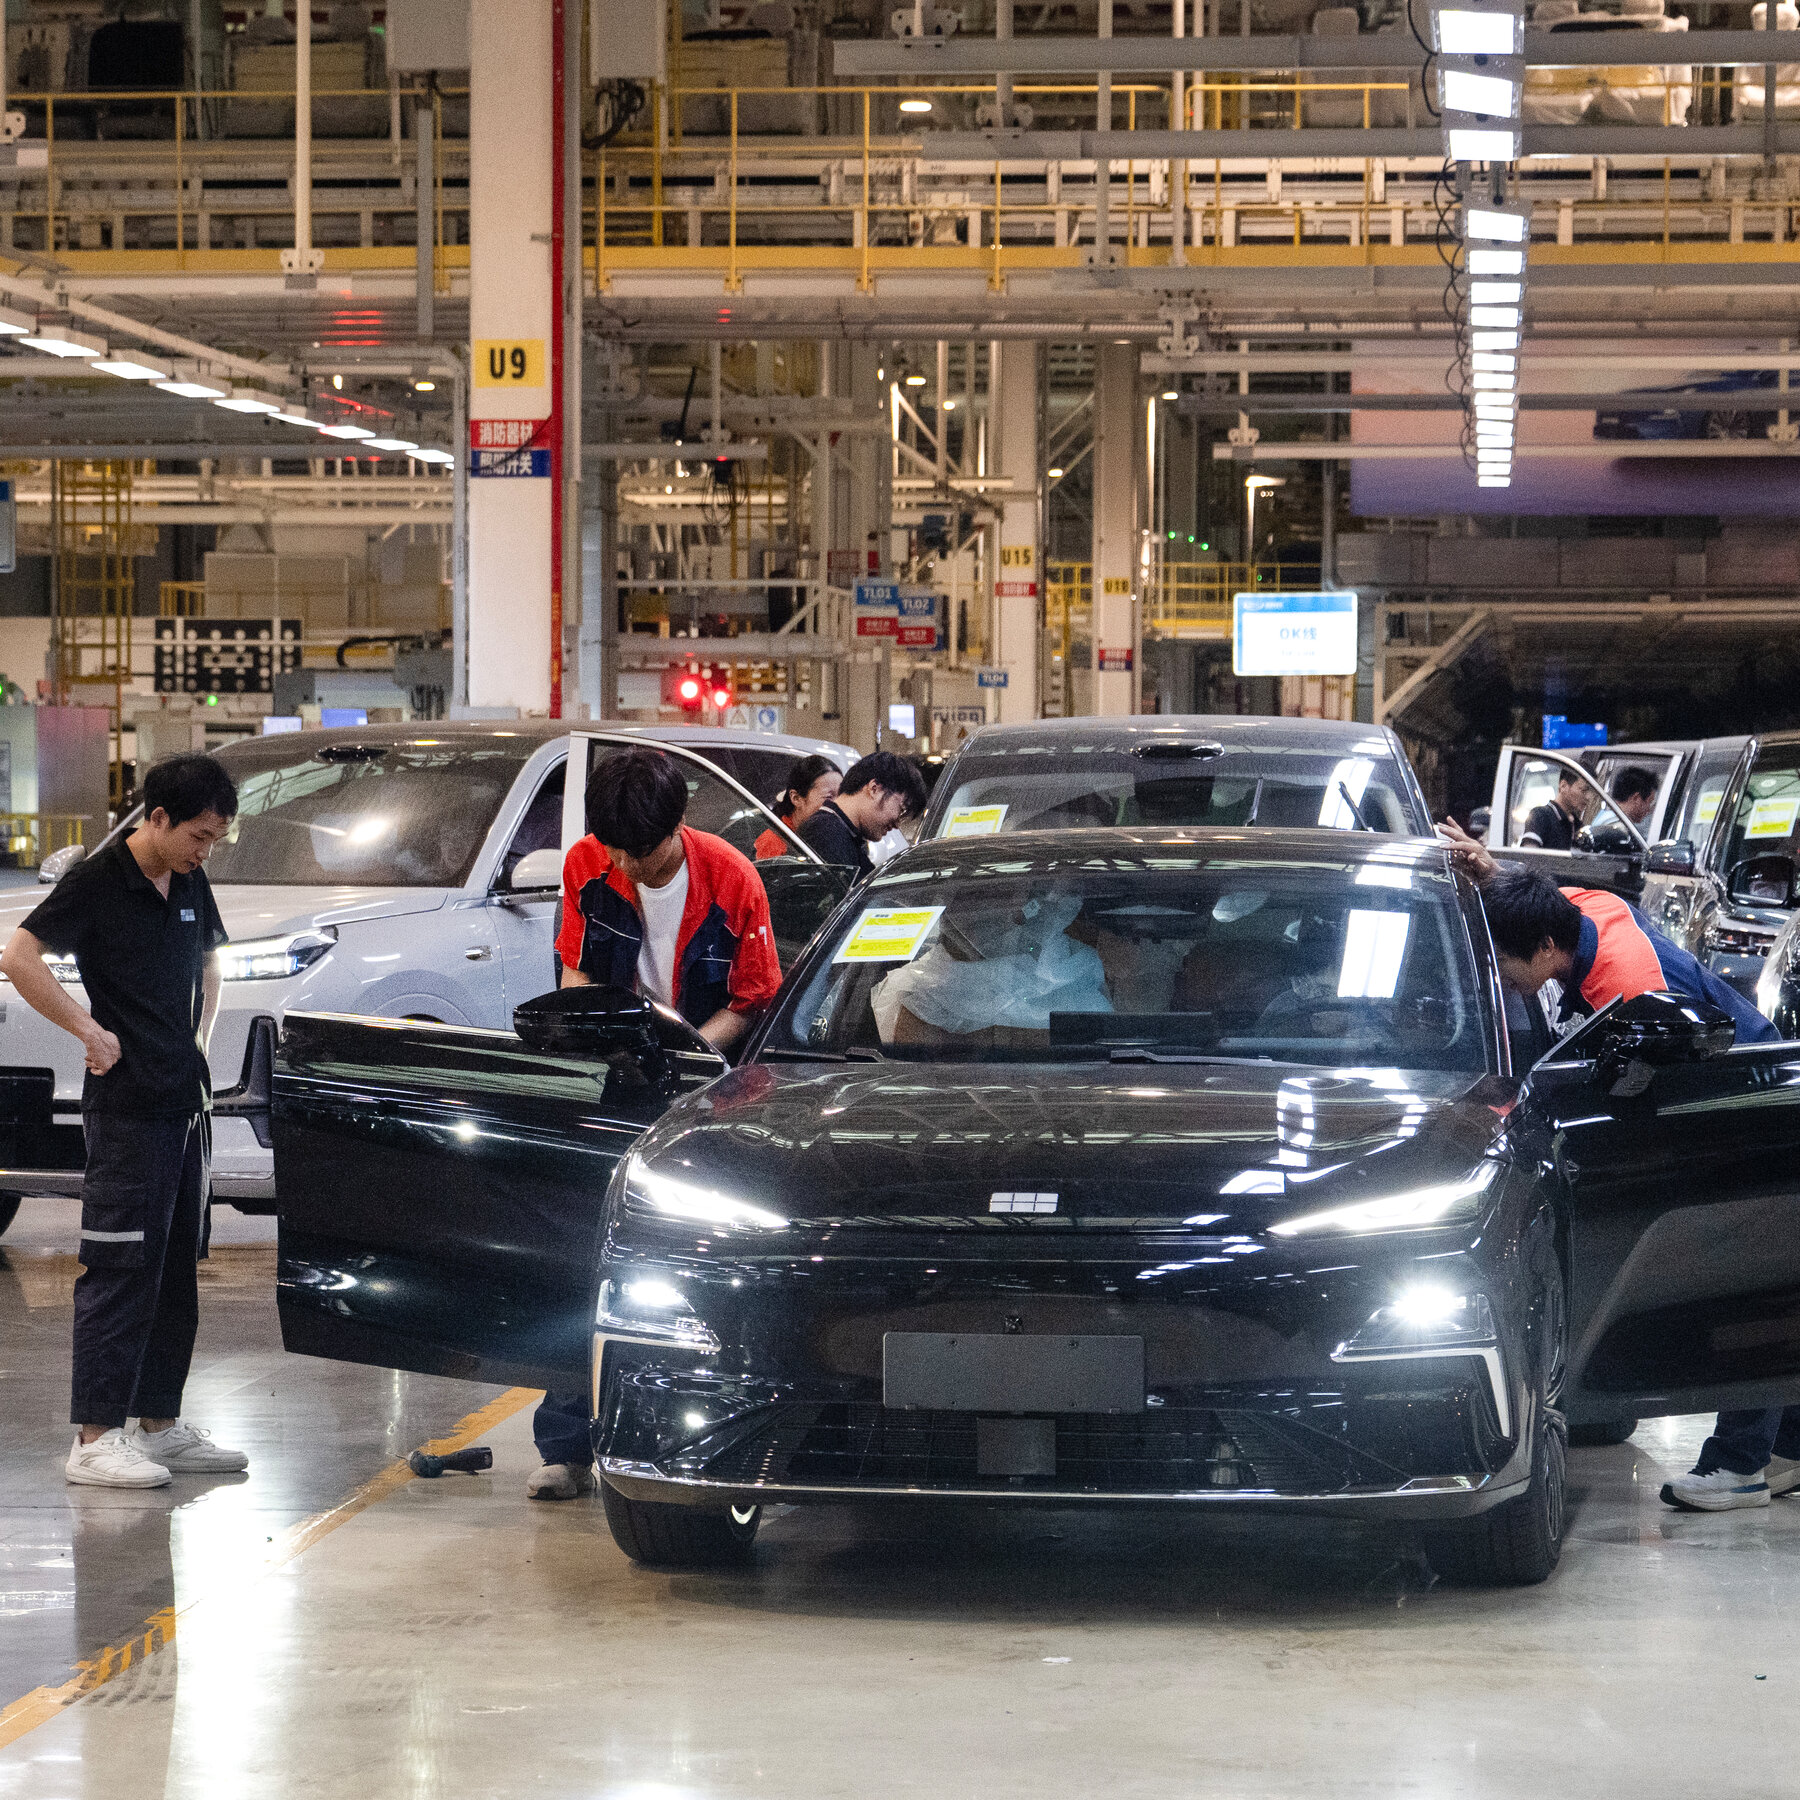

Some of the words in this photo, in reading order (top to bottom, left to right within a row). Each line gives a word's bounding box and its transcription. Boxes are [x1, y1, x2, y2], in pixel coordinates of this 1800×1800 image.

[489, 347, 527, 380] U9
[480, 421, 533, 445] 消防器材
[1002, 549, 1031, 565] U15
[902, 598, 929, 612] TL02
[1279, 627, 1317, 640] OK线
